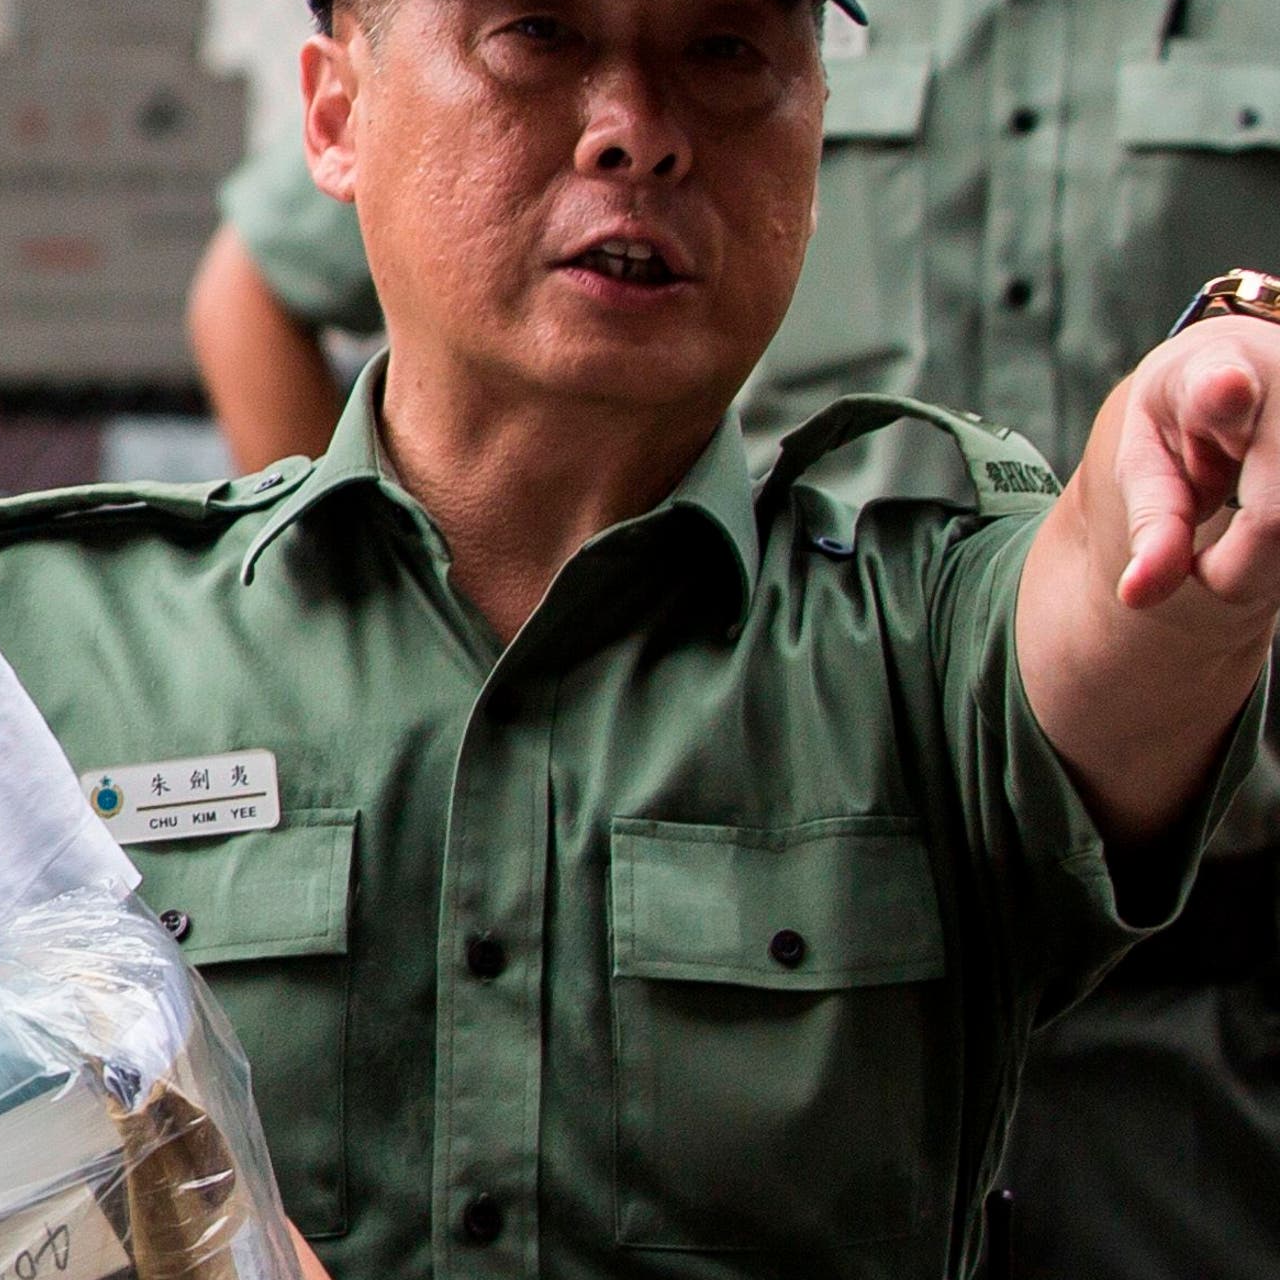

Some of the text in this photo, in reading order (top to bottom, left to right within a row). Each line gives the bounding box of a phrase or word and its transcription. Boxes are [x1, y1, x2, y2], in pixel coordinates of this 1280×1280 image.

[149, 805, 257, 829] CHU KIM YEE
